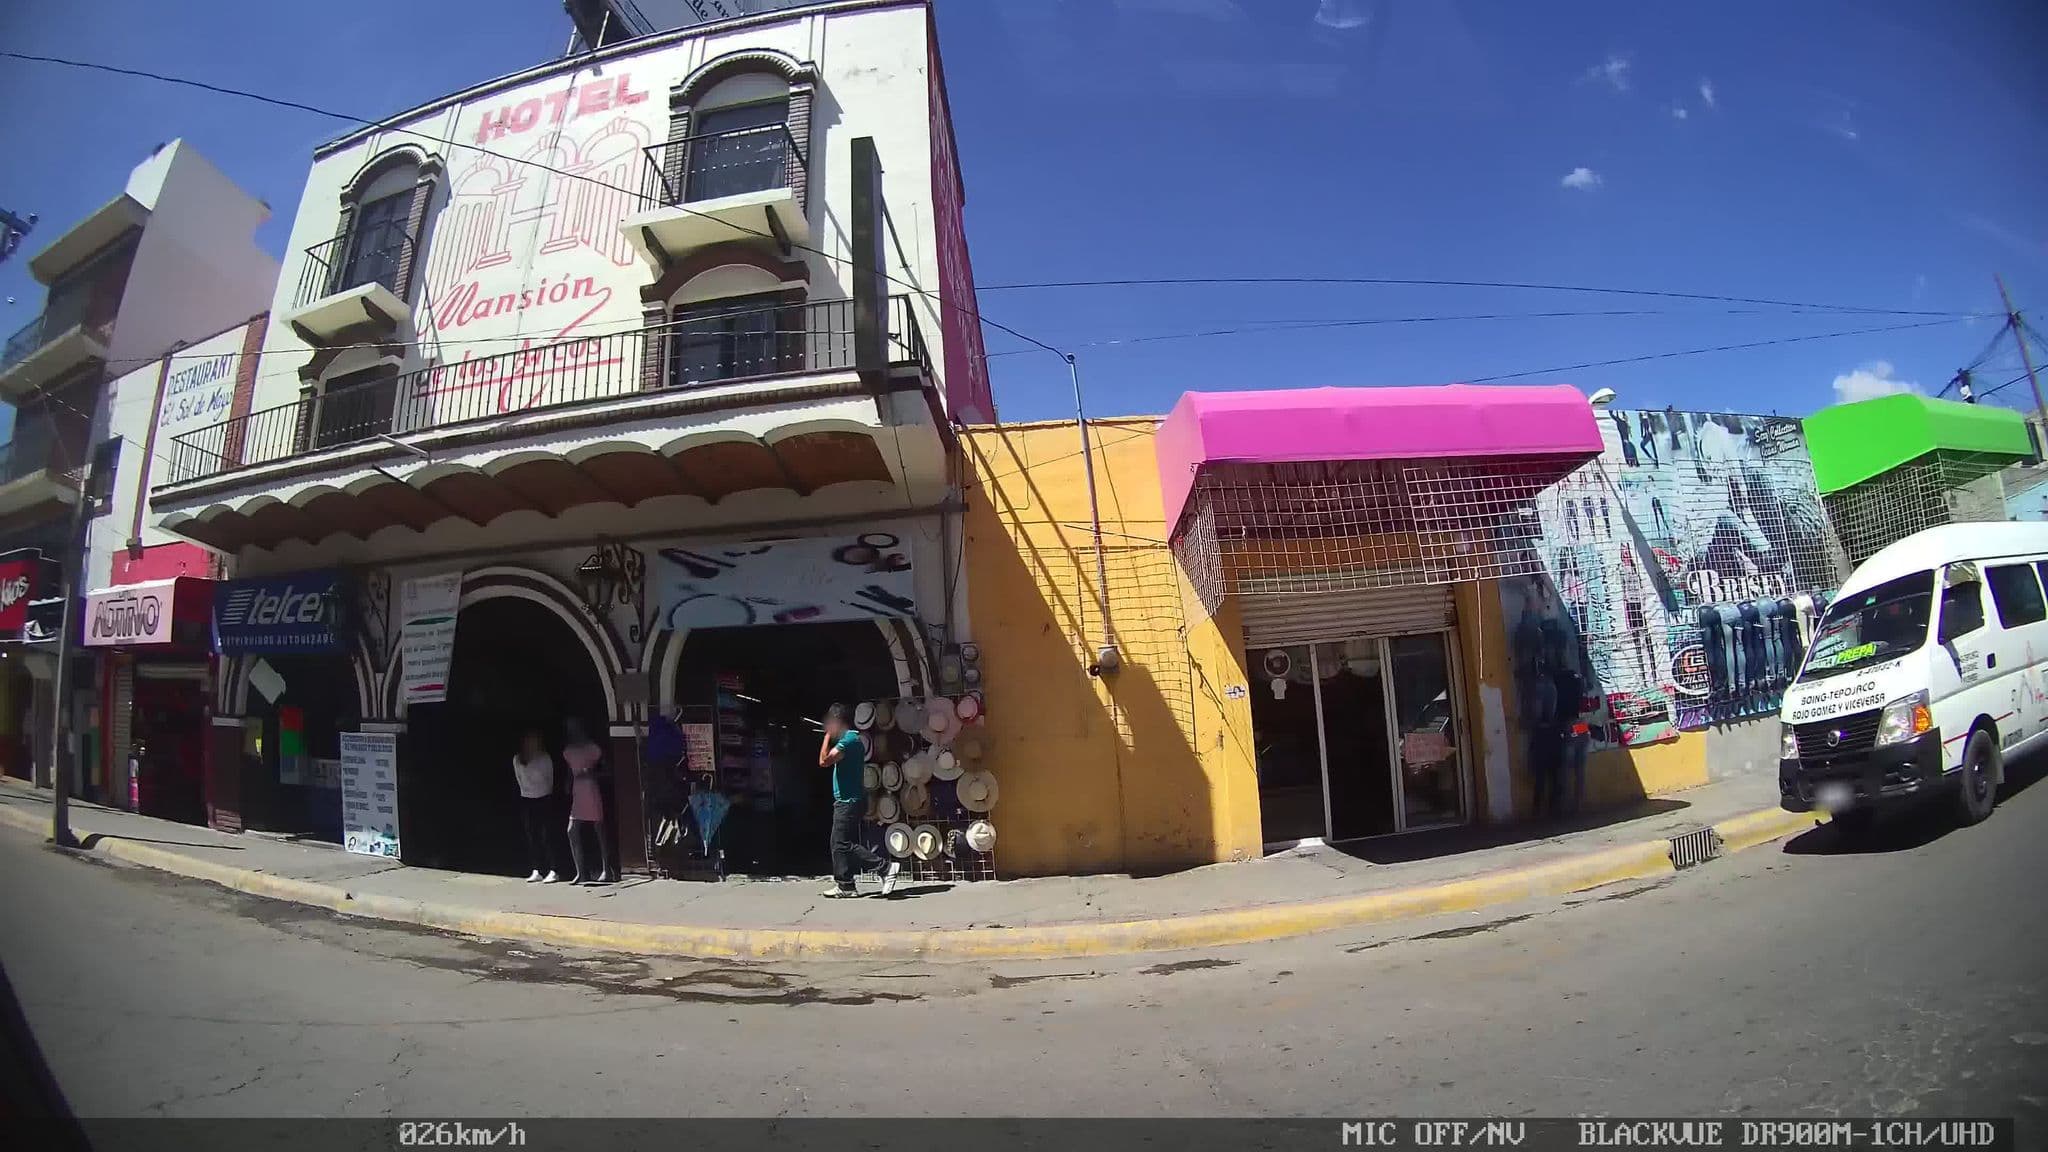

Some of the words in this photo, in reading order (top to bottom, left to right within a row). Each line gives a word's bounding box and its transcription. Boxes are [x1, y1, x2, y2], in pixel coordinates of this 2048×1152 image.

[475, 73, 649, 145] HOTEL
[419, 272, 610, 338] Mansión
[168, 352, 236, 395] RESTAURANT
[458, 350, 499, 380] los
[514, 338, 602, 375] Arcos
[1837, 643, 1875, 664] PREPA
[1792, 707, 1810, 721] ROJO
[1810, 703, 1837, 718] GOMEZ
[1838, 702, 1844, 712] Y
[1845, 693, 1886, 711] VICEVERSA
